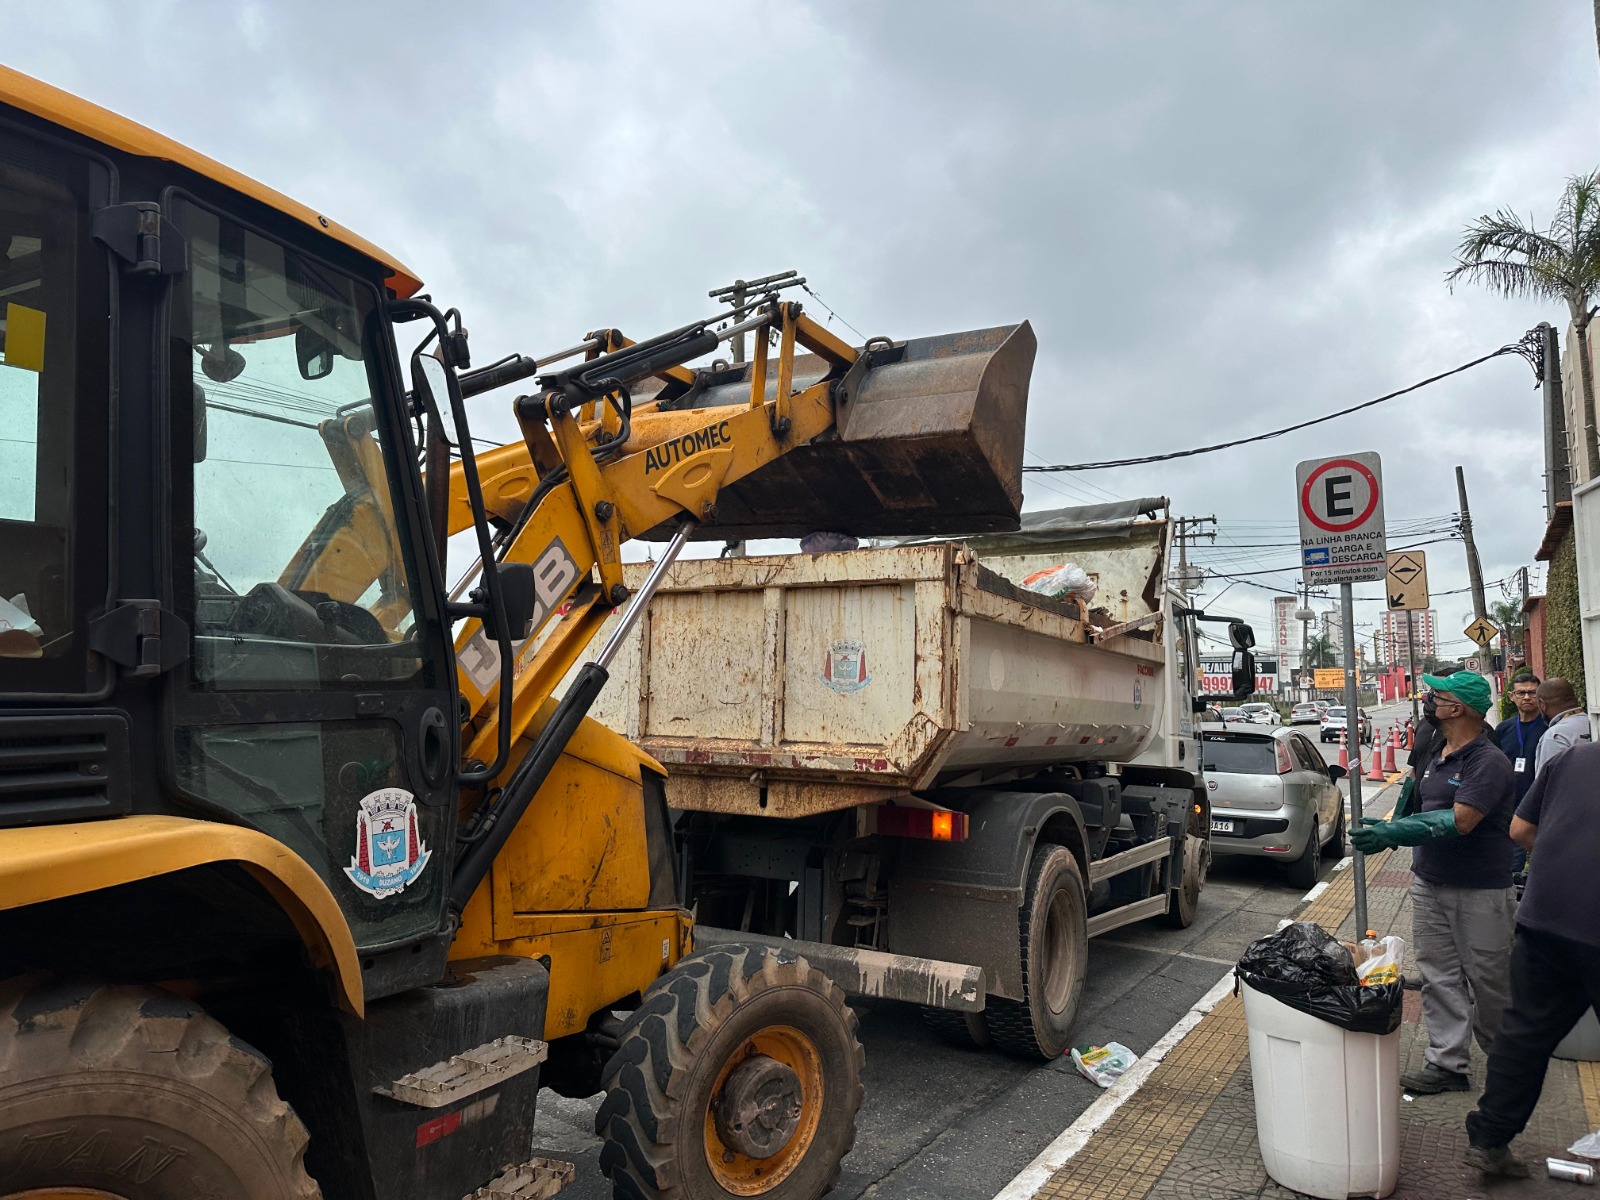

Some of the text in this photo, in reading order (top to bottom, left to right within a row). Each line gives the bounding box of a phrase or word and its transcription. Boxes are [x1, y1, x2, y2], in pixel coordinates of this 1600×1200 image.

[645, 420, 731, 475] AUTOMEC
[1325, 475, 1353, 517] E
[1316, 536, 1342, 545] LINHA
[1344, 532, 1382, 542] BRANCA
[1331, 544, 1363, 553] CARGA
[1331, 552, 1383, 563] DESCARGA
[1333, 567, 1361, 575] minutos
[1313, 575, 1353, 584] pisca-alerta
[458, 546, 576, 687] JB
[1279, 604, 1287, 646] SUZANO
[1469, 661, 1475, 669] E
[378, 875, 403, 886] SUZANO
